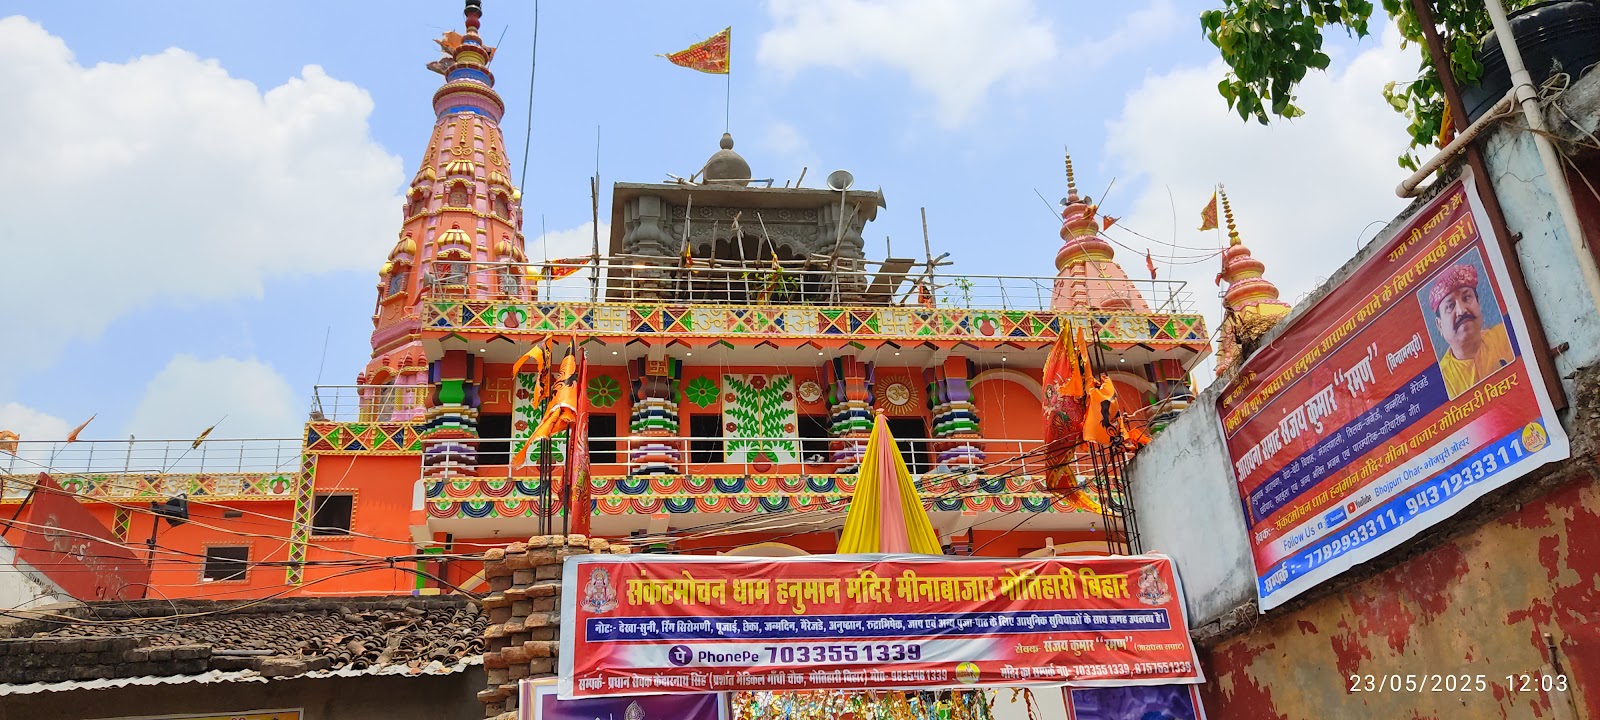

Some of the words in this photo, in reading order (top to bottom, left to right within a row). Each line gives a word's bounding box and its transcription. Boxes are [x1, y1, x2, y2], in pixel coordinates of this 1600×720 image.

[1387, 240, 1407, 265] राम
[1406, 228, 1422, 247] जी
[1421, 202, 1451, 235] हमारे
[1225, 409, 1242, 433] किसी
[1240, 401, 1250, 419] भी
[1249, 393, 1262, 412] शुभ
[1261, 374, 1284, 401] अवसर
[1282, 366, 1294, 384] पर
[1293, 344, 1321, 375] हनुमान
[1320, 315, 1356, 353] आराधना
[1355, 295, 1381, 324] कराने
[1380, 285, 1393, 304] के
[1392, 268, 1414, 295] लिए
[1414, 238, 1448, 277] सम्पर्क
[1235, 443, 1262, 483] आराधना
[1259, 427, 1282, 461] सम्राट
[1278, 403, 1308, 445] संजय
[1304, 382, 1338, 433] कुमार
[1274, 501, 1311, 531] संकटमोचन
[1311, 490, 1329, 508] धाम
[1328, 471, 1359, 498] हनुमान
[1359, 457, 1382, 479] मंदिर
[1383, 441, 1408, 464] मीना
[1408, 423, 1438, 449] बाजार
[1438, 390, 1484, 431] मोतिहारी
[1485, 372, 1518, 402] बिहार
[1326, 454, 1340, 469] भजन
[1341, 446, 1350, 460] एवं
[1408, 402, 1420, 417] गीत
[1282, 529, 1304, 551] Follow
[1304, 523, 1315, 538] Us
[1374, 473, 1403, 499] Bhojpuri
[1423, 448, 1449, 469] भोजपुरी
[1405, 438, 1523, 514] 9431233311
[626, 569, 727, 606] संकटमोचन
[732, 576, 772, 606] धाम
[777, 576, 841, 615] हनुमान
[845, 570, 892, 605] मंदिर
[897, 569, 995, 603] मीनाबाजार
[1000, 567, 1076, 601] मोतिहारी
[1080, 566, 1131, 599] बिहार
[618, 620, 659, 636] देखा-सुनी,
[661, 620, 675, 633] रिंग
[676, 620, 714, 634] सिरोमणी,
[764, 619, 799, 633] जन्मदिन,
[866, 617, 906, 631] रुद्राभिषेक,
[907, 618, 924, 629] जाप
[925, 616, 937, 629] एवं
[938, 618, 955, 628] अन्य
[989, 615, 998, 627] के
[998, 614, 1015, 627] लिए
[1016, 613, 1048, 629] आधुनिक
[1049, 612, 1083, 629] सुविधाओं
[1083, 612, 1092, 624] के
[1093, 614, 1108, 624] साथ
[1109, 614, 1128, 624] जगह
[1129, 613, 1154, 624] उपलब्ध
[698, 650, 759, 663] PhonePe
[764, 644, 921, 664] 7033551339
[1042, 636, 1069, 653] संजय
[1069, 639, 1095, 657] कुमार
[607, 675, 631, 689] प्रधान
[632, 673, 652, 689] सेवक
[736, 671, 765, 686] मेडिकल
[808, 669, 842, 685] मोतिहारी
[1032, 663, 1055, 677] सम्पर्क
[1135, 661, 1192, 674] 8757551339
